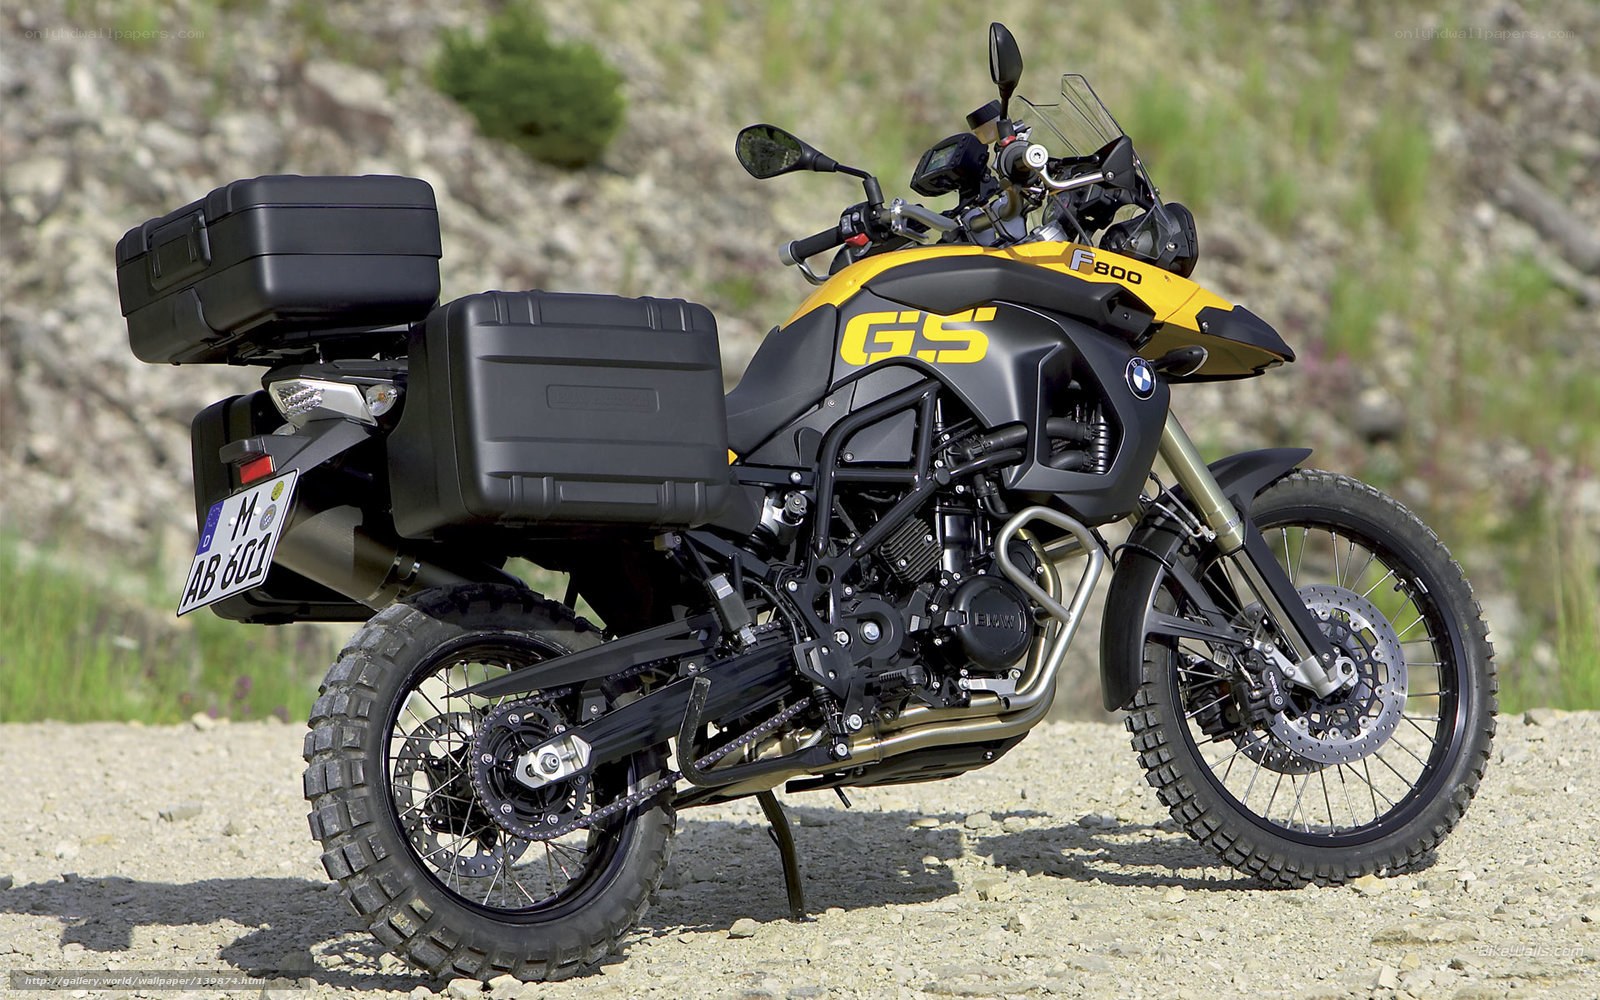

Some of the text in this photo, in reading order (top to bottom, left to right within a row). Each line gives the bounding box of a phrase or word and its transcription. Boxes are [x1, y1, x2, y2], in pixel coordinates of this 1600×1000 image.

[839, 306, 998, 366] GS
[202, 534, 211, 548] D
[230, 491, 260, 541] M
[182, 531, 273, 607] AB 601
